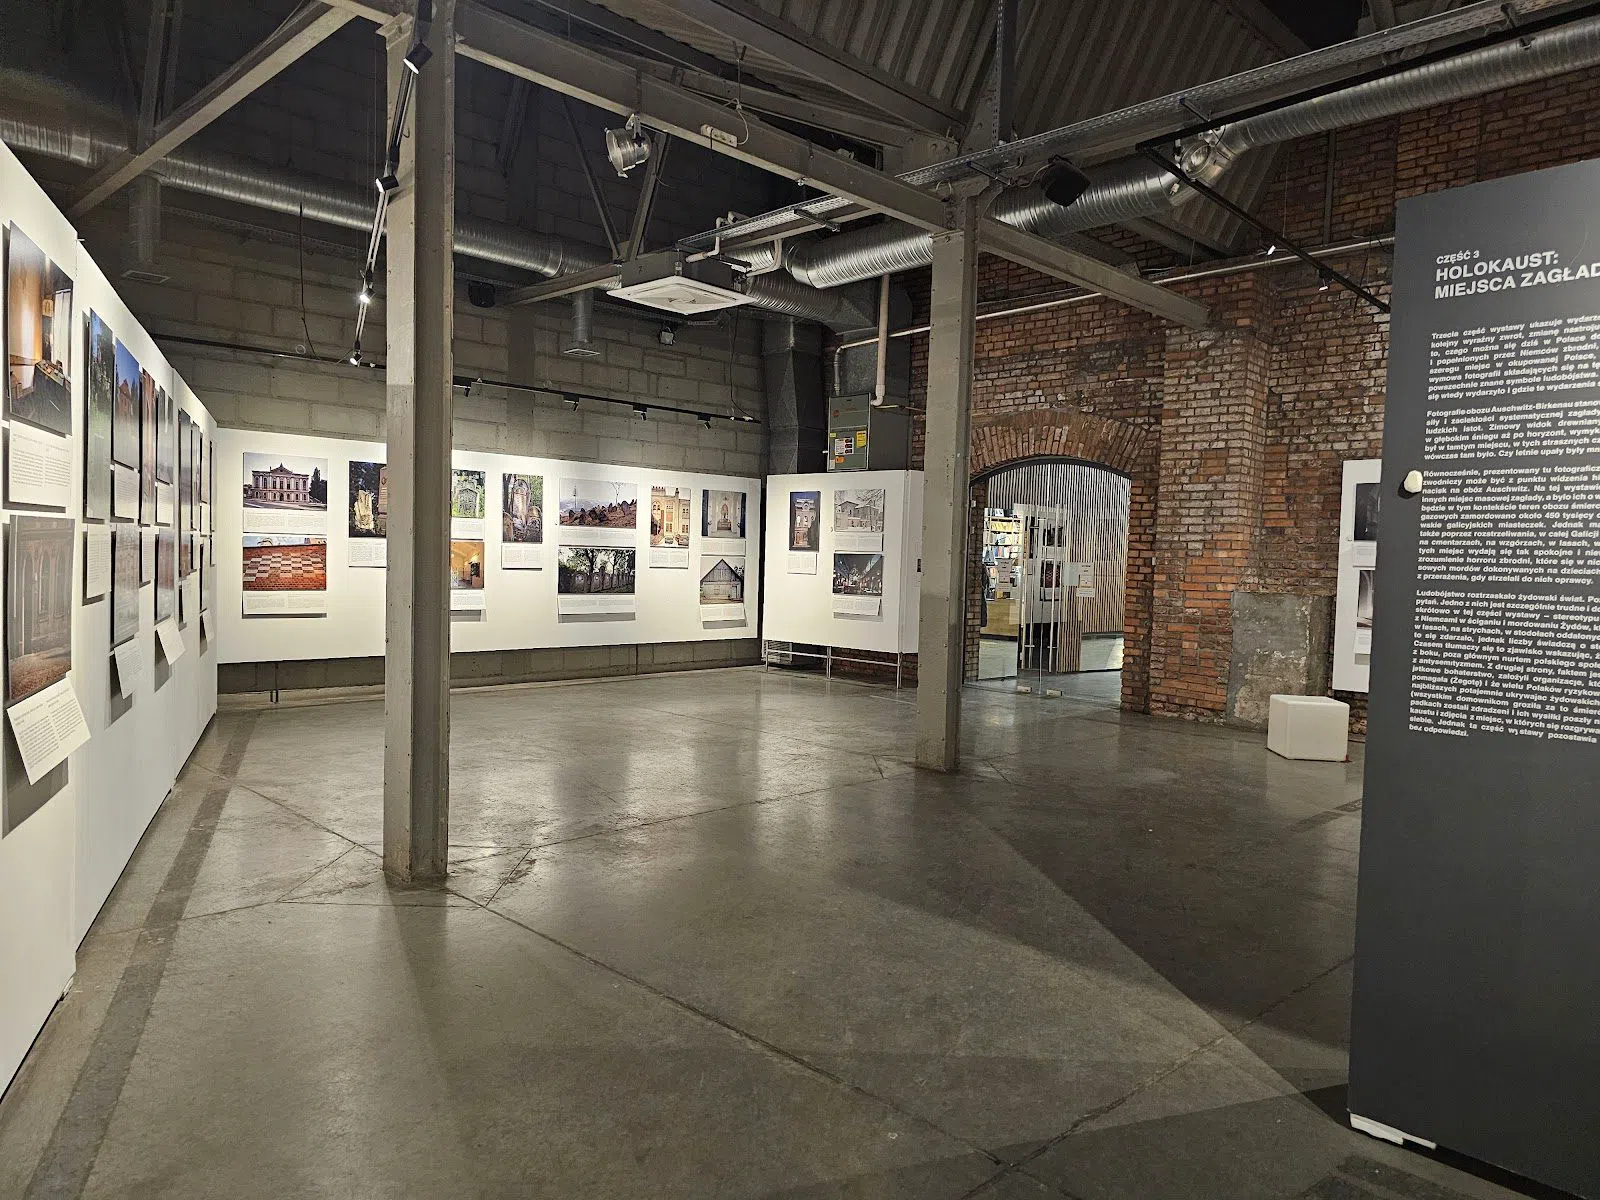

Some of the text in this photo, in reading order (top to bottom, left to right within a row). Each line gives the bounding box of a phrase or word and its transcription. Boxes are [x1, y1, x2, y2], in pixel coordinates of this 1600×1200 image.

[1436, 249, 1480, 265] CZĘŚĆ 3
[1436, 250, 1559, 281] HOLOKAUST:
[1434, 276, 1516, 299] MIEJSCA
[1431, 330, 1459, 340] Trzecia
[1489, 323, 1526, 334] wystawy
[1529, 318, 1563, 329] ukazuje
[1430, 340, 1459, 349] kolejny
[1555, 335, 1587, 344] Polsce
[1493, 351, 1516, 361] przez
[1519, 347, 1559, 357] Niemców
[1507, 355, 1559, 367] okupowanej
[1464, 369, 1501, 380] fotografii
[1440, 391, 1464, 399] wtedy
[1511, 385, 1535, 395] gdzie
[1546, 380, 1596, 392] wydarzenia
[1426, 408, 1466, 418] Fotografie
[1466, 407, 1491, 415] obozu
[1425, 426, 1458, 435] ludzkich
[1488, 423, 1521, 431] Zimowy
[1526, 420, 1552, 429] widok
[1521, 439, 1541, 448] tych
[1542, 437, 1590, 446] strasznych
[1497, 449, 1514, 458] Czy
[1422, 478, 1463, 486] zwodniczy
[1516, 475, 1547, 485] punktu
[1549, 474, 1589, 482] widzenia
[1422, 487, 1447, 495] nacisk
[1462, 486, 1483, 494] obóz
[1548, 484, 1561, 493] tej
[1421, 495, 1448, 504] innych
[1447, 495, 1474, 504] miejsc
[1474, 494, 1510, 503] masowej
[1456, 504, 1472, 513] tym
[1420, 513, 1459, 521] gazowych
[1544, 511, 1561, 519] 450
[1551, 521, 1584, 529] Jednak
[1570, 530, 1600, 539] Galicji
[1418, 547, 1436, 555] tych
[1533, 548, 1574, 557] spokojne
[1466, 556, 1497, 564] horroru
[1470, 574, 1487, 583] gdy
[1534, 575, 1553, 583] nich
[1439, 599, 1465, 607] Jedno
[1471, 600, 1489, 608] nich
[1489, 600, 1506, 609] jest
[1556, 604, 1586, 612] trudne
[1415, 606, 1451, 615] skrótowo
[1462, 608, 1474, 617] tej
[1504, 611, 1541, 620] wystawy
[1420, 615, 1458, 624] Niemcami
[1507, 620, 1559, 629] mordowaniu
[1477, 635, 1505, 644] jednak
[1508, 637, 1534, 647] liczby
[1413, 639, 1443, 648] Czasem
[1506, 646, 1544, 656] zjawisko
[1442, 651, 1462, 659] poza
[1501, 656, 1532, 664] nurtem
[1533, 658, 1576, 668] polskiego
[1494, 663, 1524, 673] drugiej
[1557, 668, 1588, 677] faktem
[1459, 687, 1504, 697] potajemnie
[1501, 682, 1524, 690] wielu
[1526, 683, 1563, 693] Polaków
[1455, 695, 1509, 706] domownikom
[1470, 705, 1510, 715] zdradzeni
[1516, 709, 1530, 718] ich
[1513, 718, 1546, 728] których
[1437, 718, 1466, 728] Jednak
[1547, 732, 1598, 744] pozostawia
